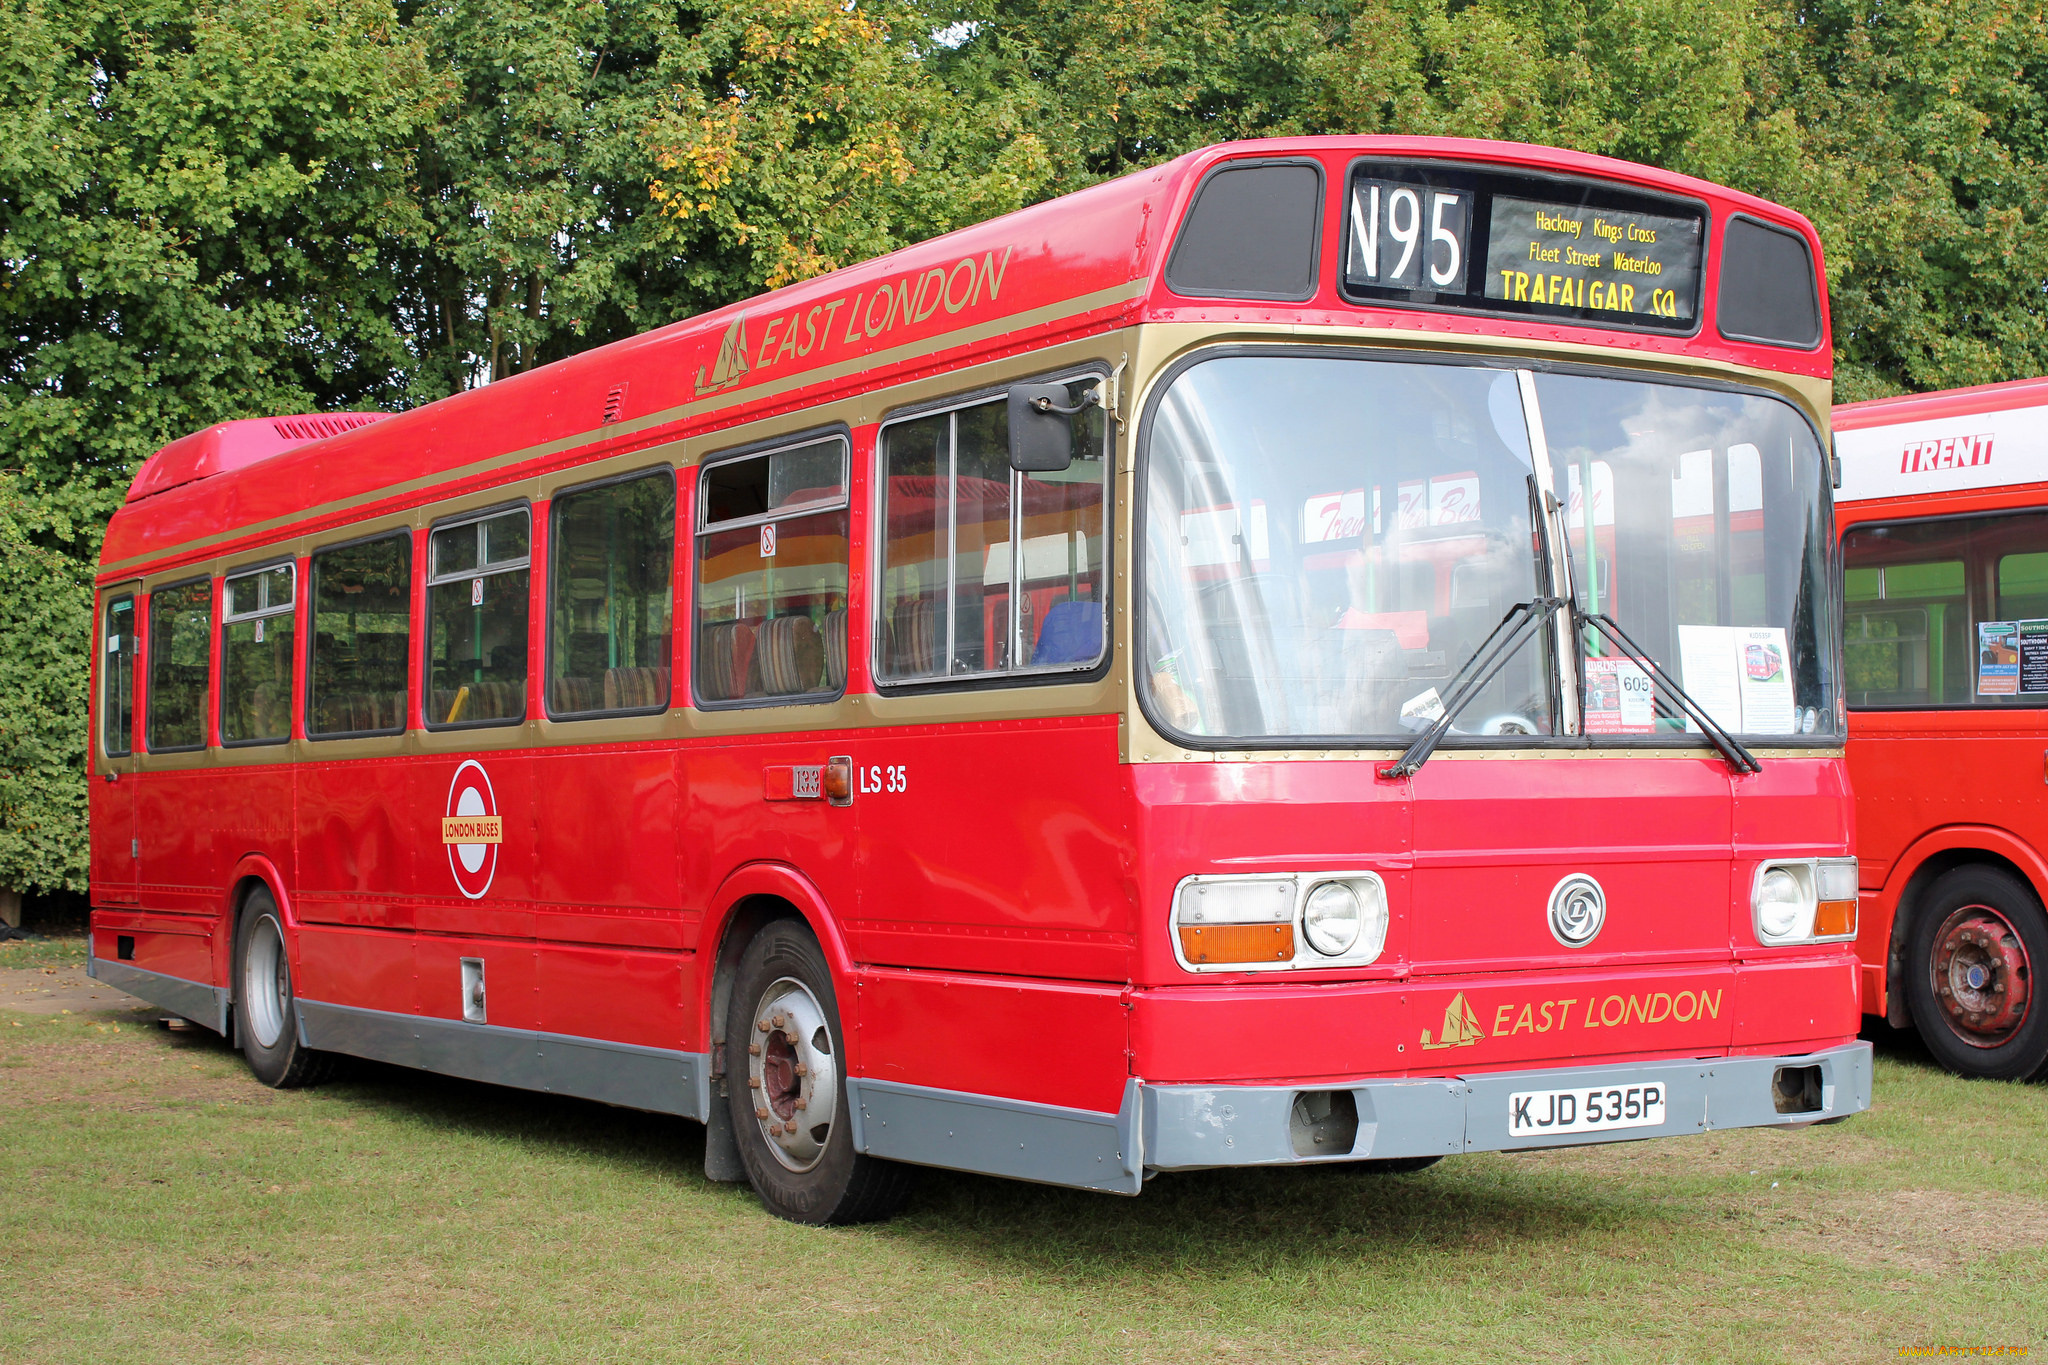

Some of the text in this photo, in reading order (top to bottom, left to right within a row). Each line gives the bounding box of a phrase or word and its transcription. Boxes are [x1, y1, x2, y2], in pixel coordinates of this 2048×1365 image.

[1347, 186, 1461, 287] N95
[1535, 211, 1657, 244] Hackney Kings Cross
[1529, 241, 1662, 276] Fleet Street Waterloo
[755, 245, 1013, 370] EAST LONDON
[1500, 269, 1677, 318] TRAFALGAR SQ
[1902, 433, 1995, 474] TRENT
[1623, 676, 1649, 692] 605
[796, 770, 820, 793] 133
[860, 765, 907, 793] LS 35
[445, 822, 499, 838] LONDON BUSES
[1492, 988, 1723, 1037] EAST LONDON
[1514, 1087, 1661, 1129] KJD 535P
